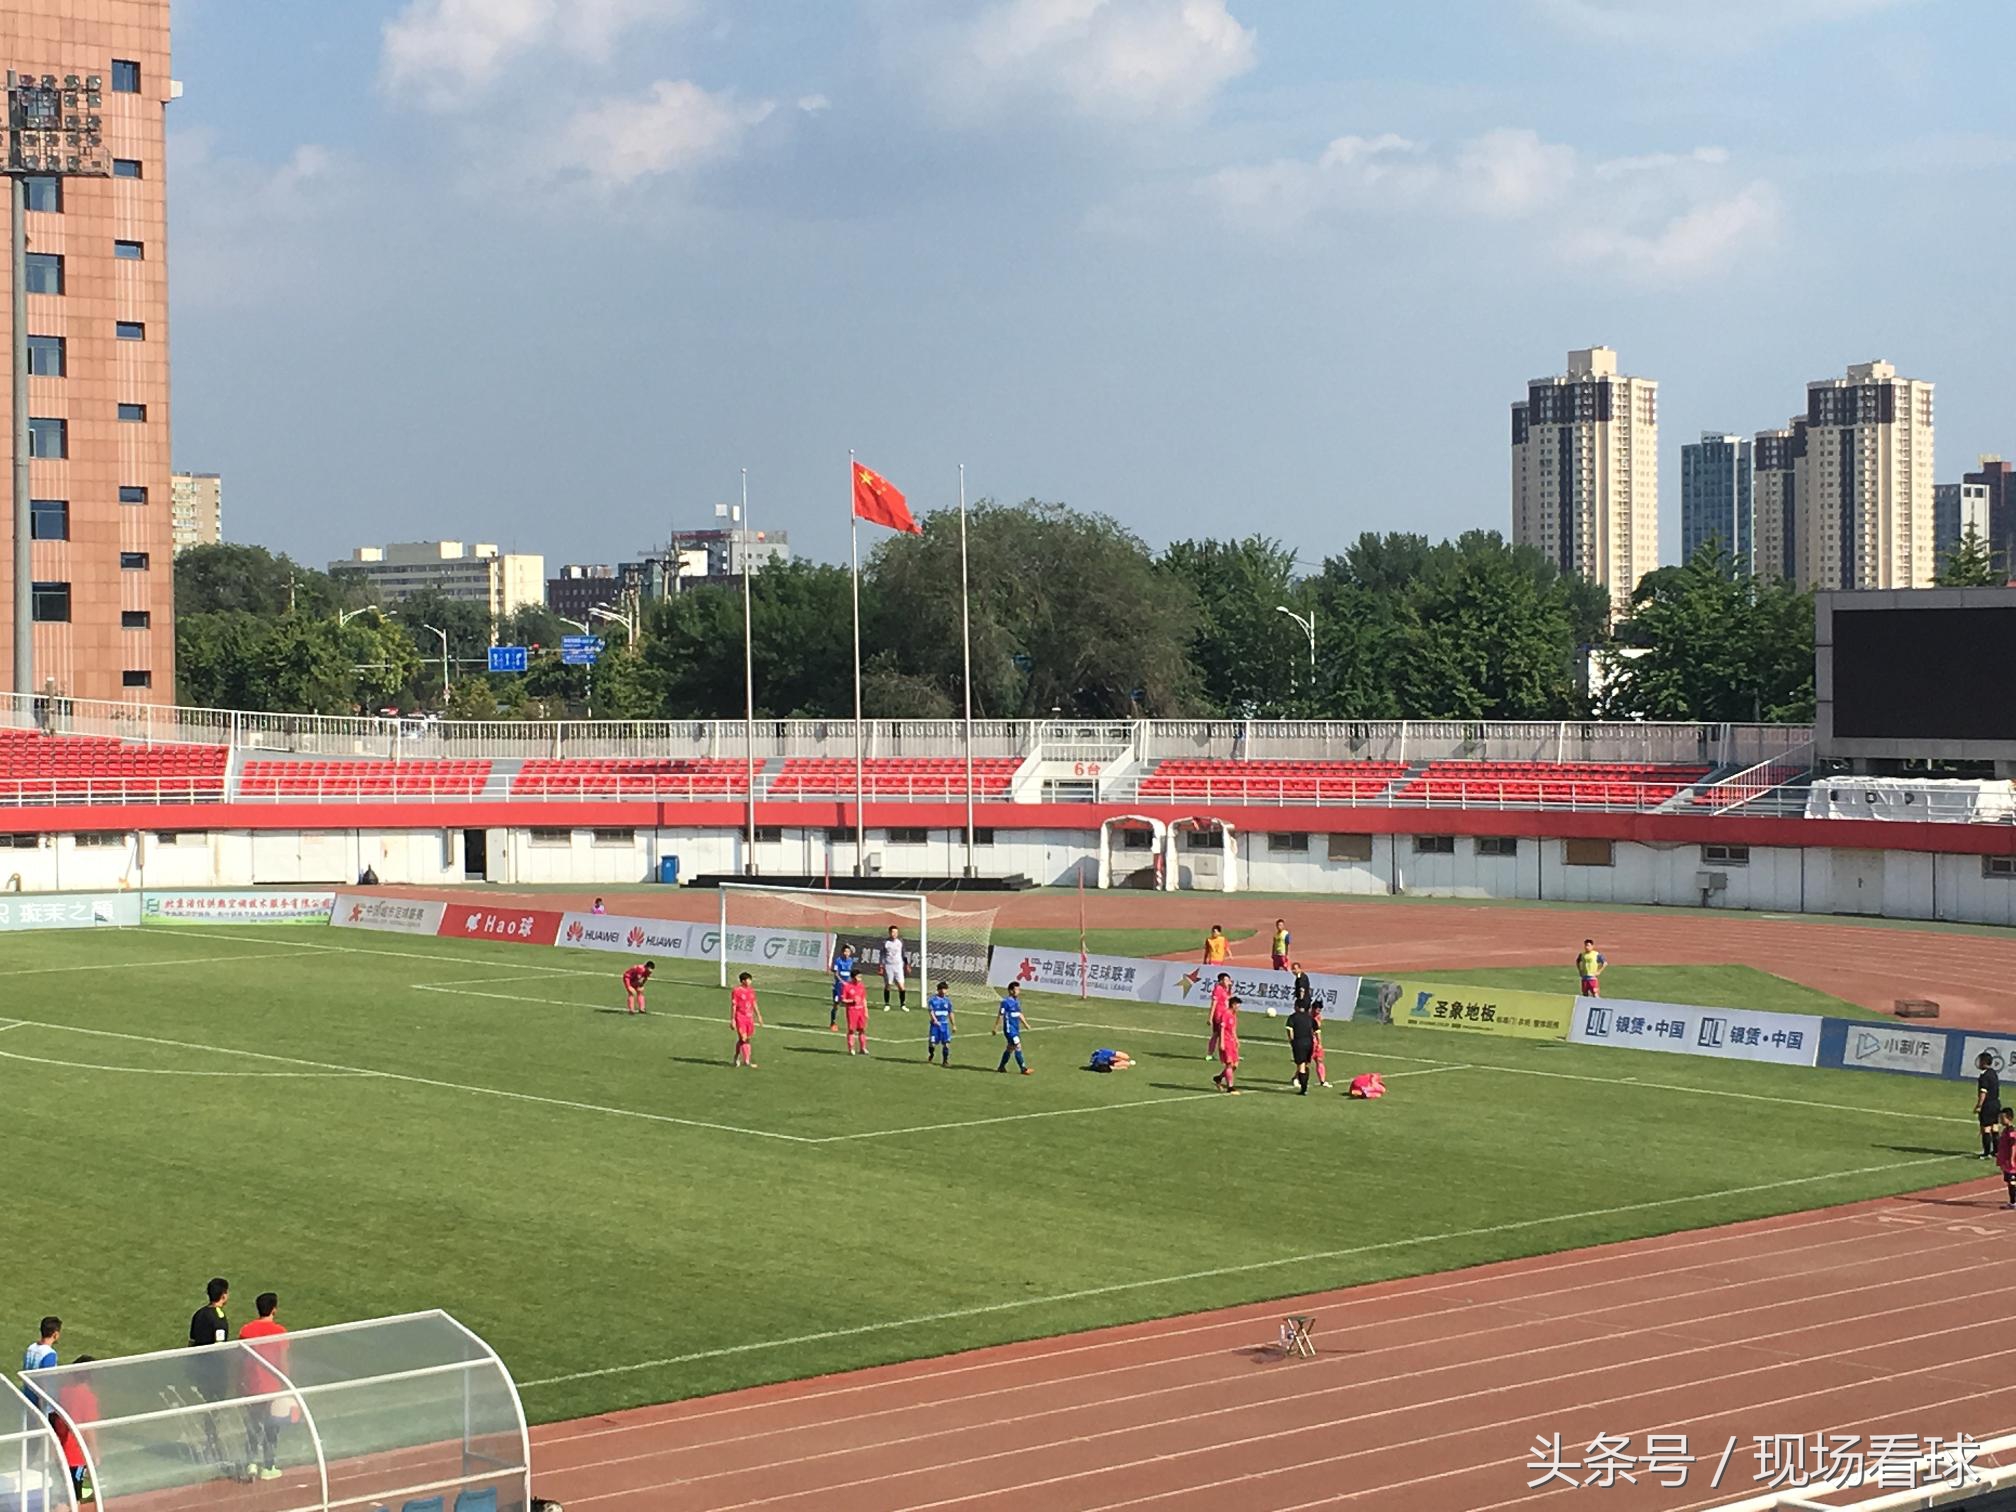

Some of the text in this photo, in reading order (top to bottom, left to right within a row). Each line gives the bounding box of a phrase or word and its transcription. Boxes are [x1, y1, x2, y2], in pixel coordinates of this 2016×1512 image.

[1074, 762, 1101, 776] 6台
[585, 929, 620, 943] HUAWEI
[646, 935, 682, 950] HUAWEI
[1433, 1000, 1497, 1023] 圣象地板
[1884, 1039, 1931, 1057] 小制作
